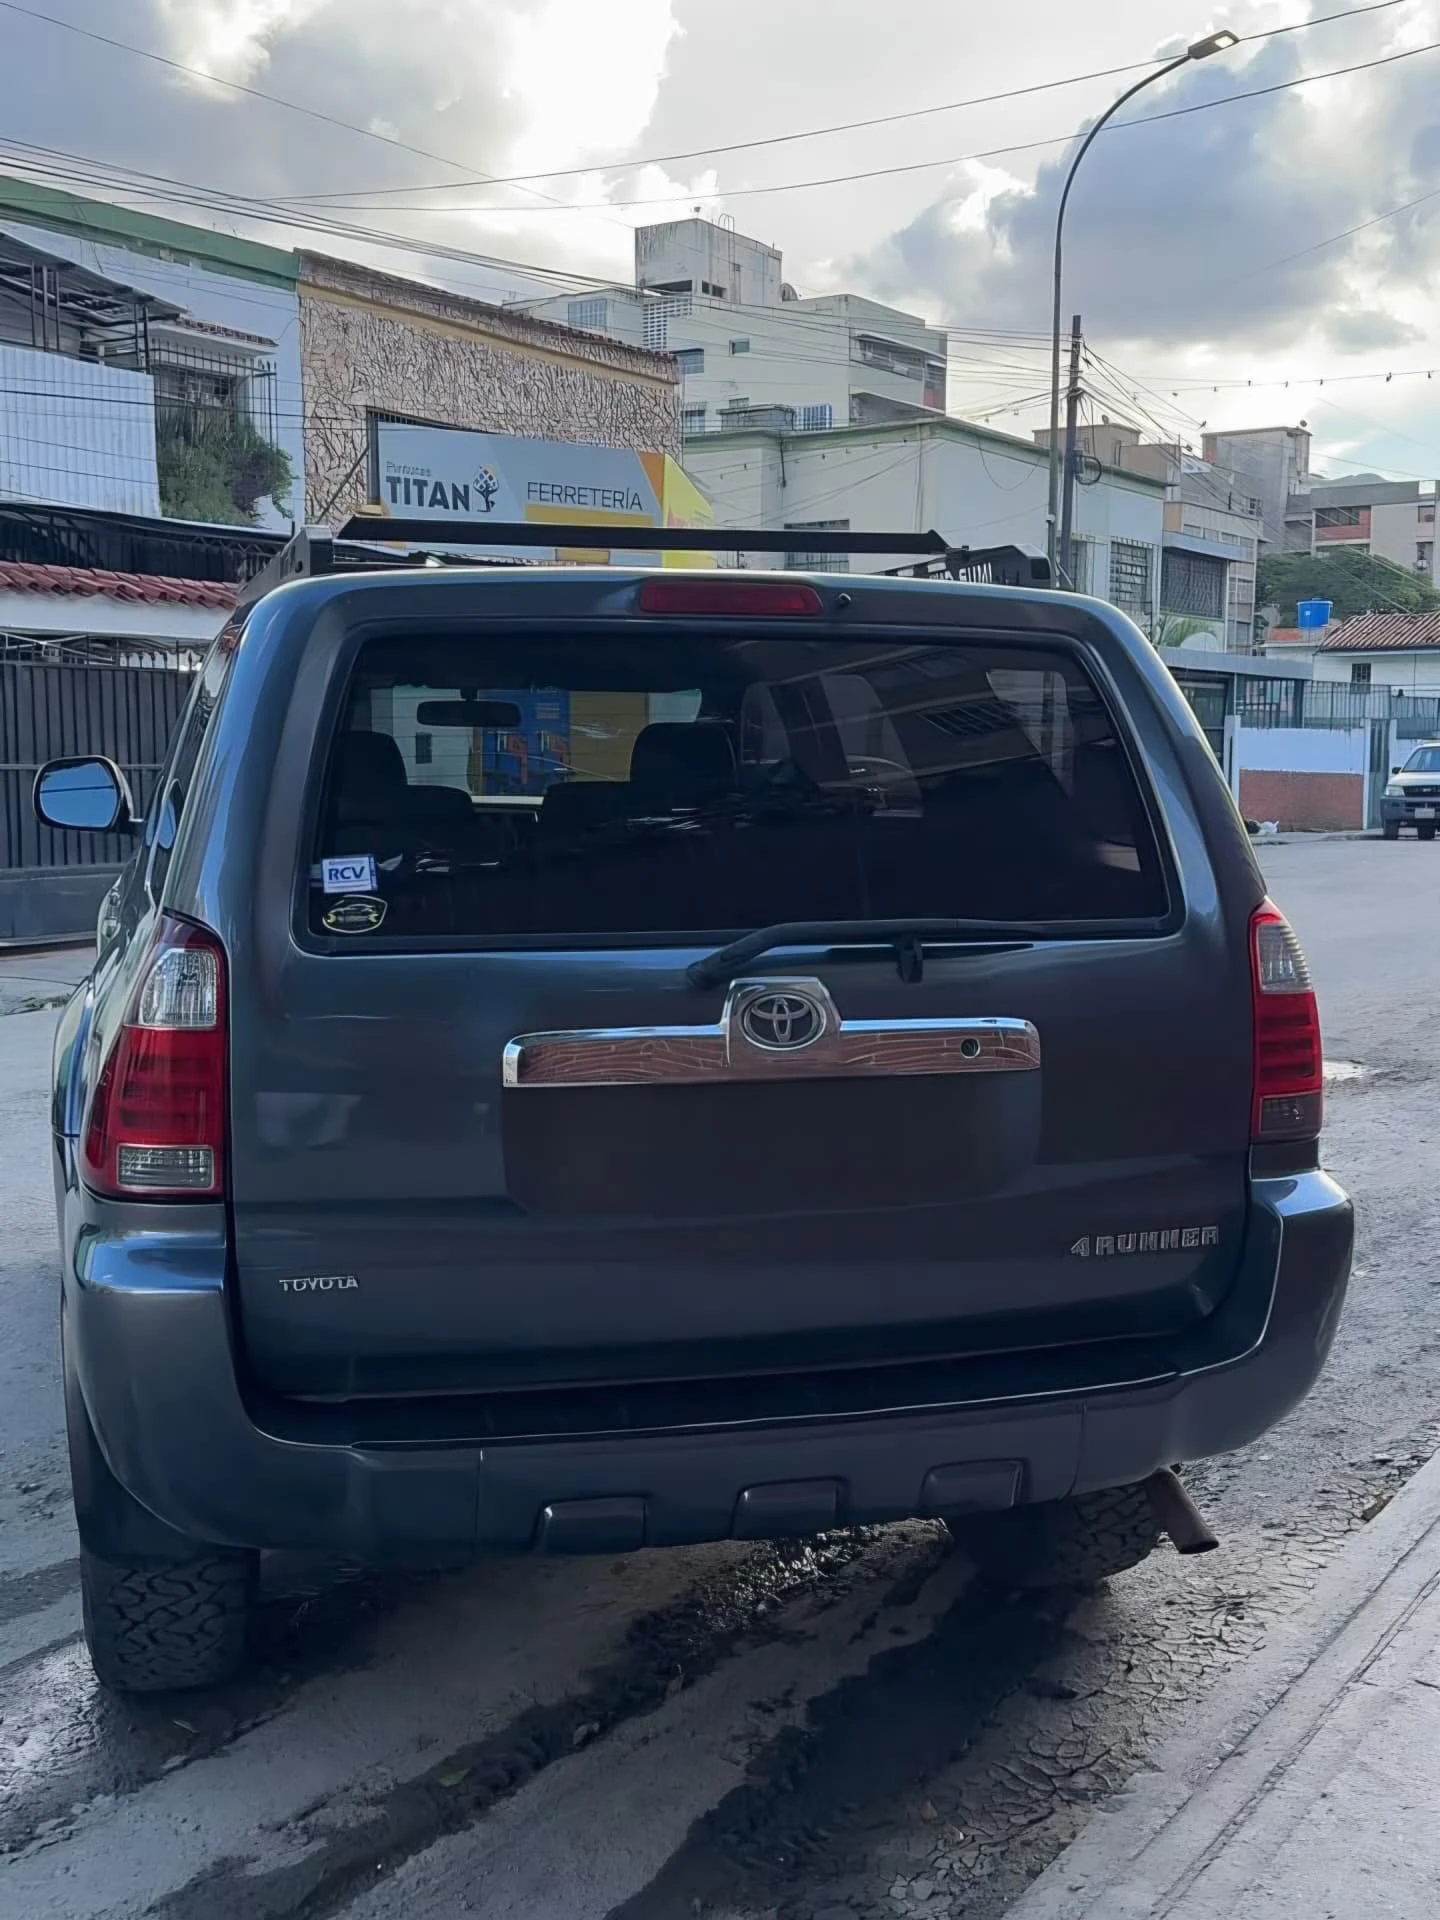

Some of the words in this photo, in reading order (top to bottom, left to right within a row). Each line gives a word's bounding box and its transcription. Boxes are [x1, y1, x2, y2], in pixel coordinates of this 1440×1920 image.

[385, 475, 470, 512] TITAN
[527, 481, 643, 511] FERRETERÍA
[328, 866, 365, 880] RCV
[1070, 1226, 1217, 1257] 4RUNNER
[279, 1276, 358, 1291] TOYOTA
